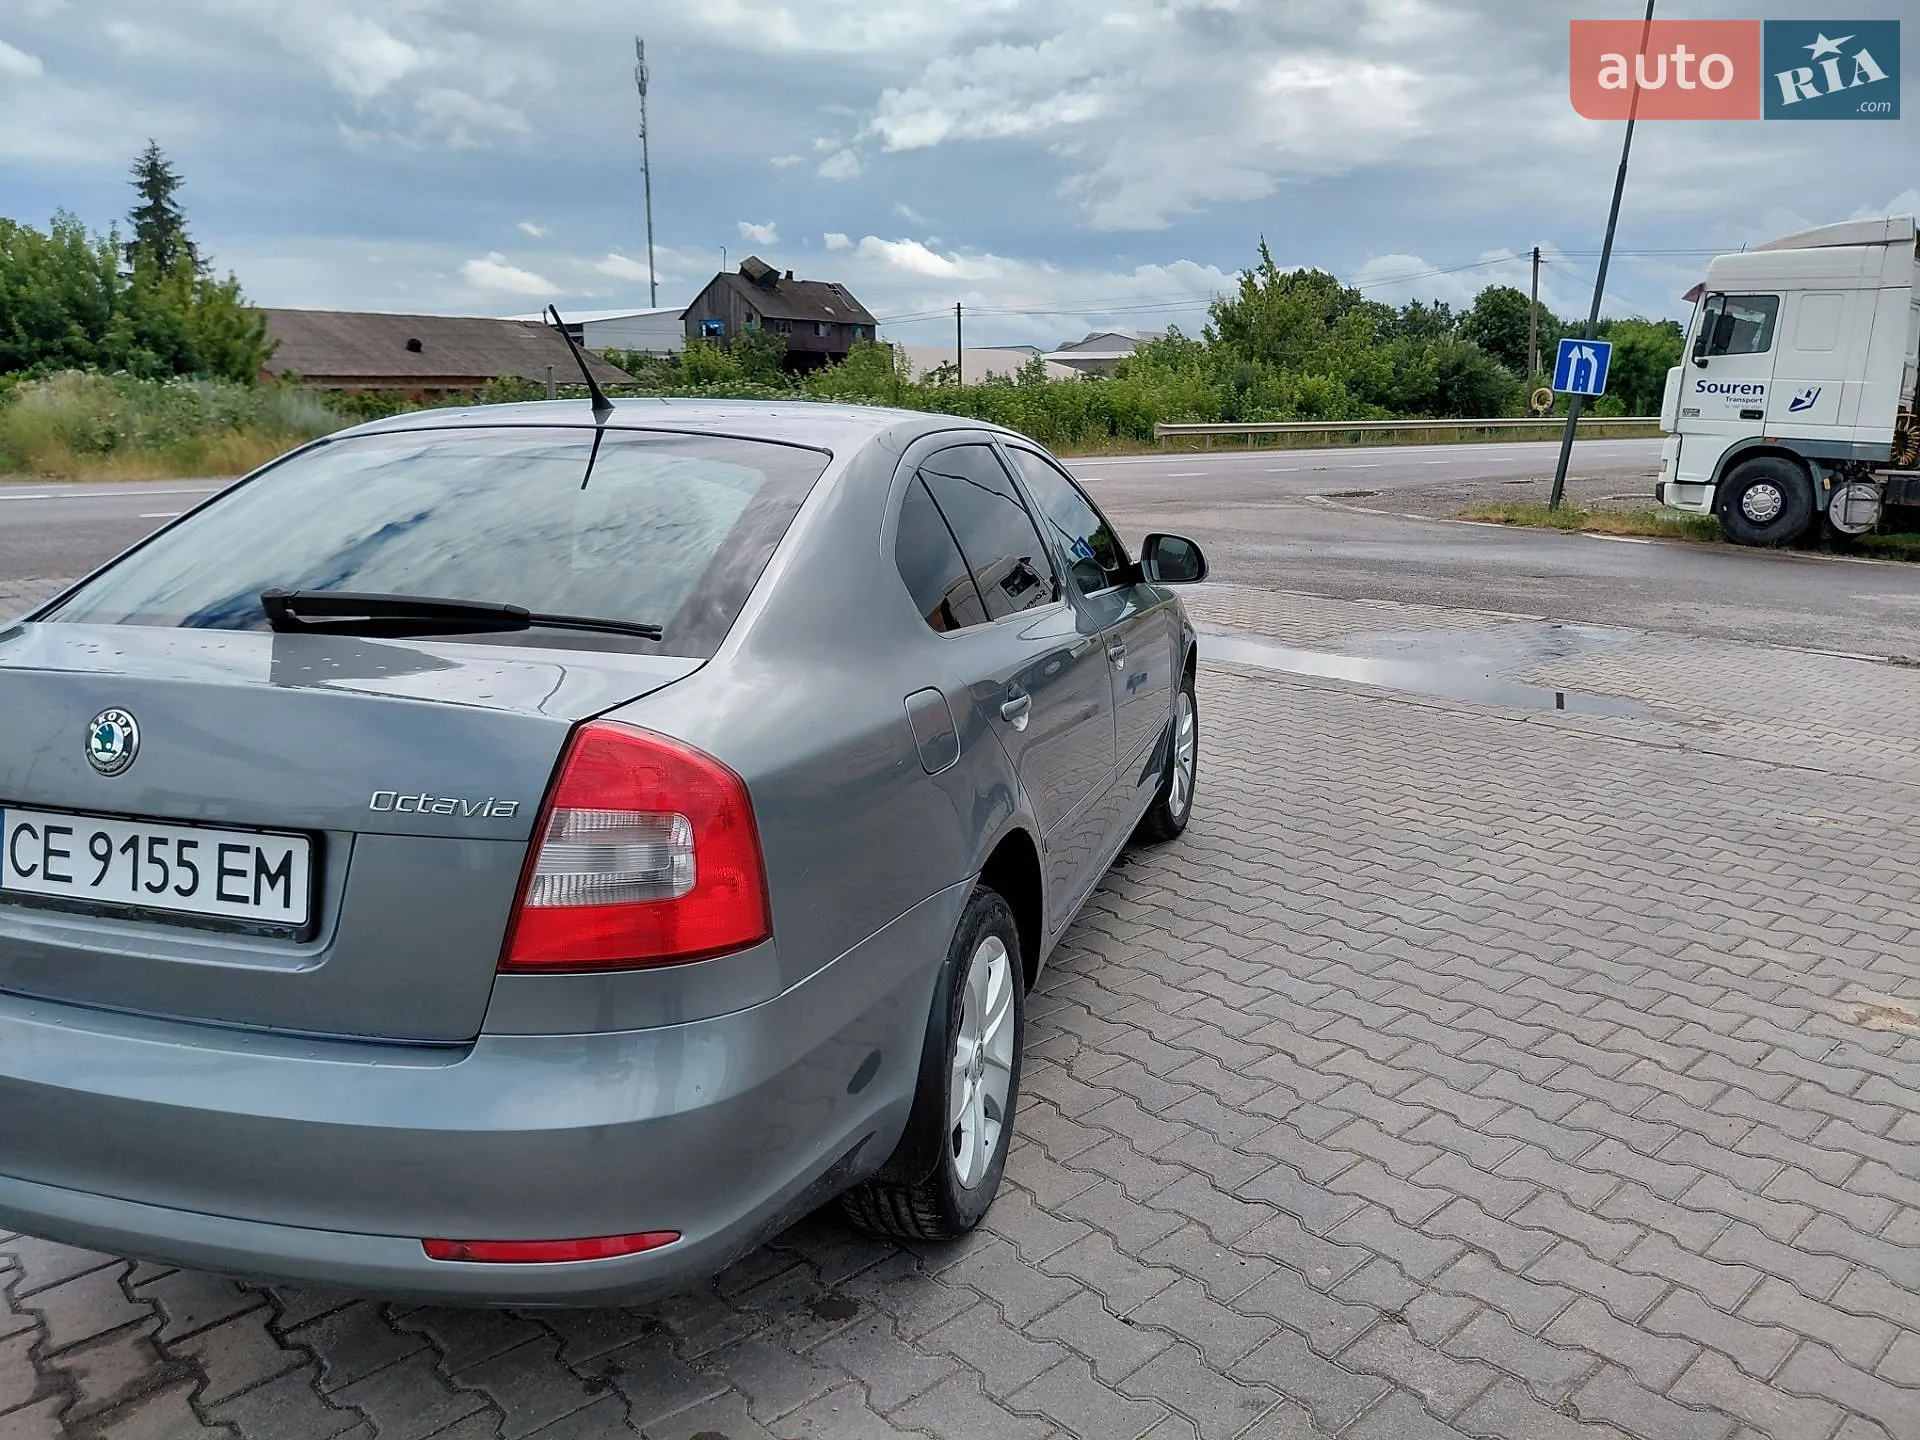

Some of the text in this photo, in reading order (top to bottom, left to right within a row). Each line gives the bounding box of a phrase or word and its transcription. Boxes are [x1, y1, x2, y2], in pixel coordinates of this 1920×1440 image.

[1695, 379, 1765, 395] Souren
[1725, 396, 1763, 405] Transport
[369, 790, 519, 818] Octavia
[10, 822, 293, 908] CE 9155 EM
